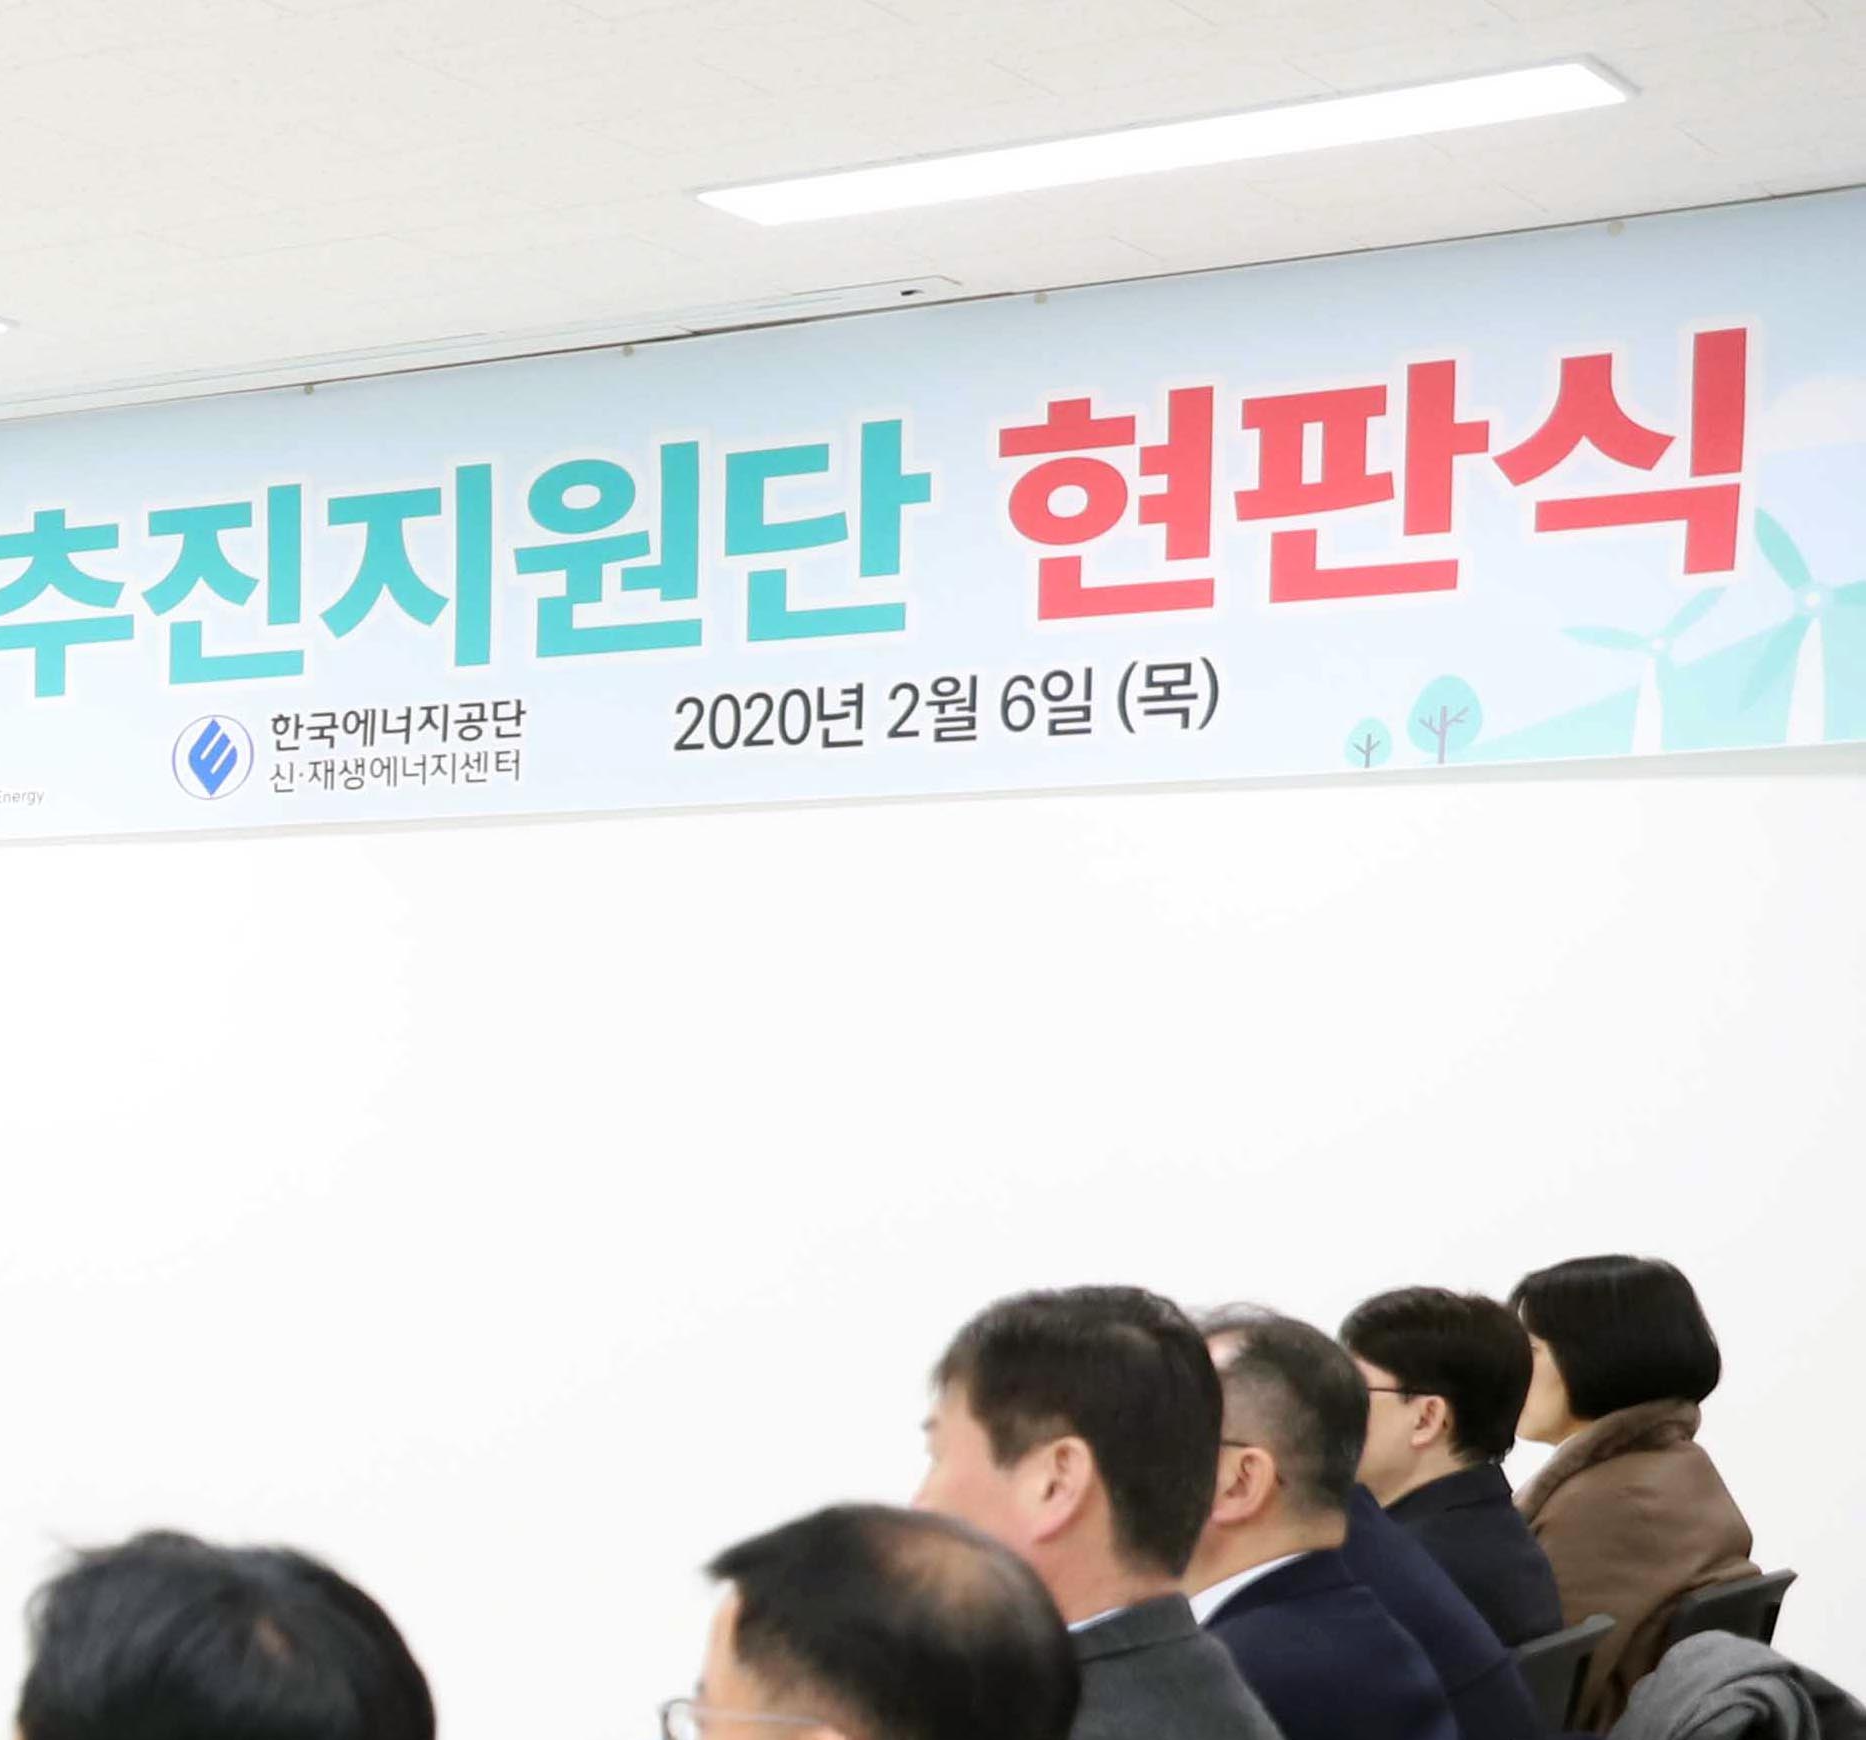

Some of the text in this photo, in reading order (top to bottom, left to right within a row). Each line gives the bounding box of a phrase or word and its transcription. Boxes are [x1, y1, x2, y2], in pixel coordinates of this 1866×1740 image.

[999, 328, 1747, 620] 현판식
[270, 698, 527, 752] 한국에너지공단
[673, 656, 1219, 751] 2020년 2월 6일 (목)
